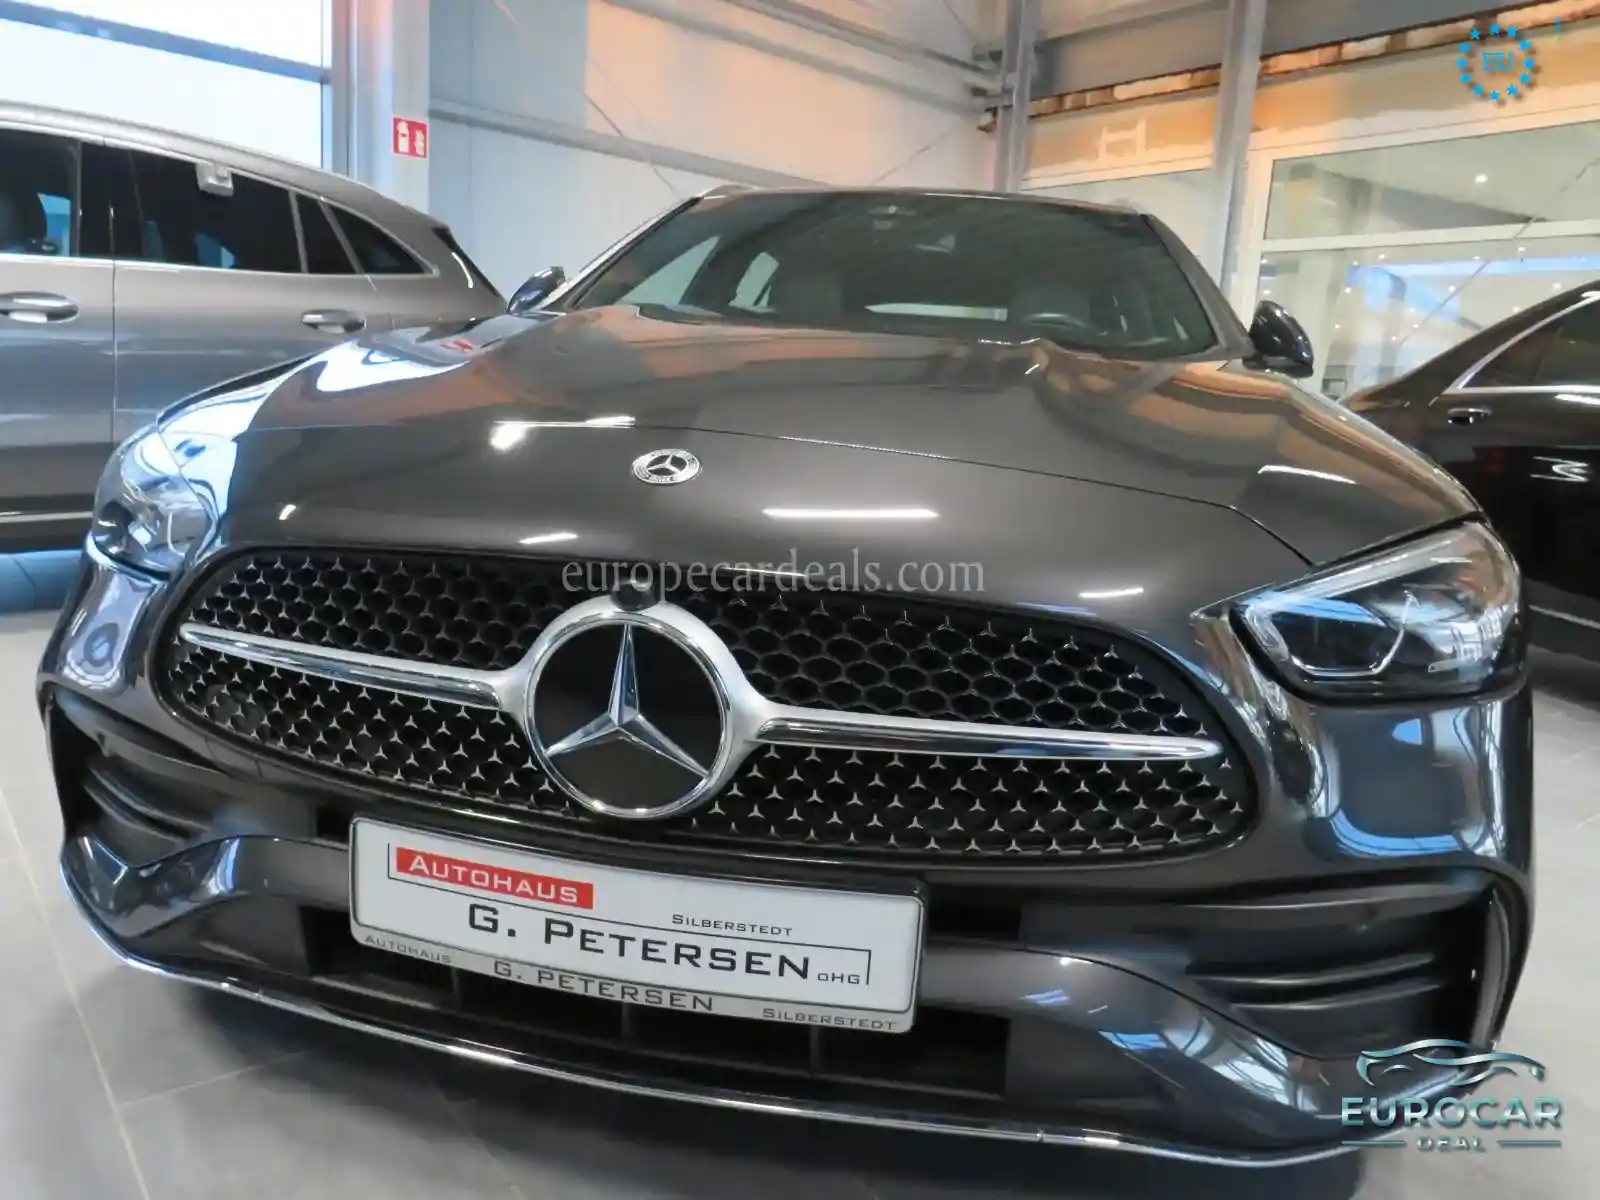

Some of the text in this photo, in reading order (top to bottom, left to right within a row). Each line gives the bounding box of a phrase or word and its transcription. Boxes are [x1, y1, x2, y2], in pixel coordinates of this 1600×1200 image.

[408, 855, 578, 902] AUTOHAUS
[364, 934, 452, 964] AUTOHAUS
[469, 903, 861, 985] G. PETERSEN oHG
[493, 961, 713, 1011] G. PETERSEN
